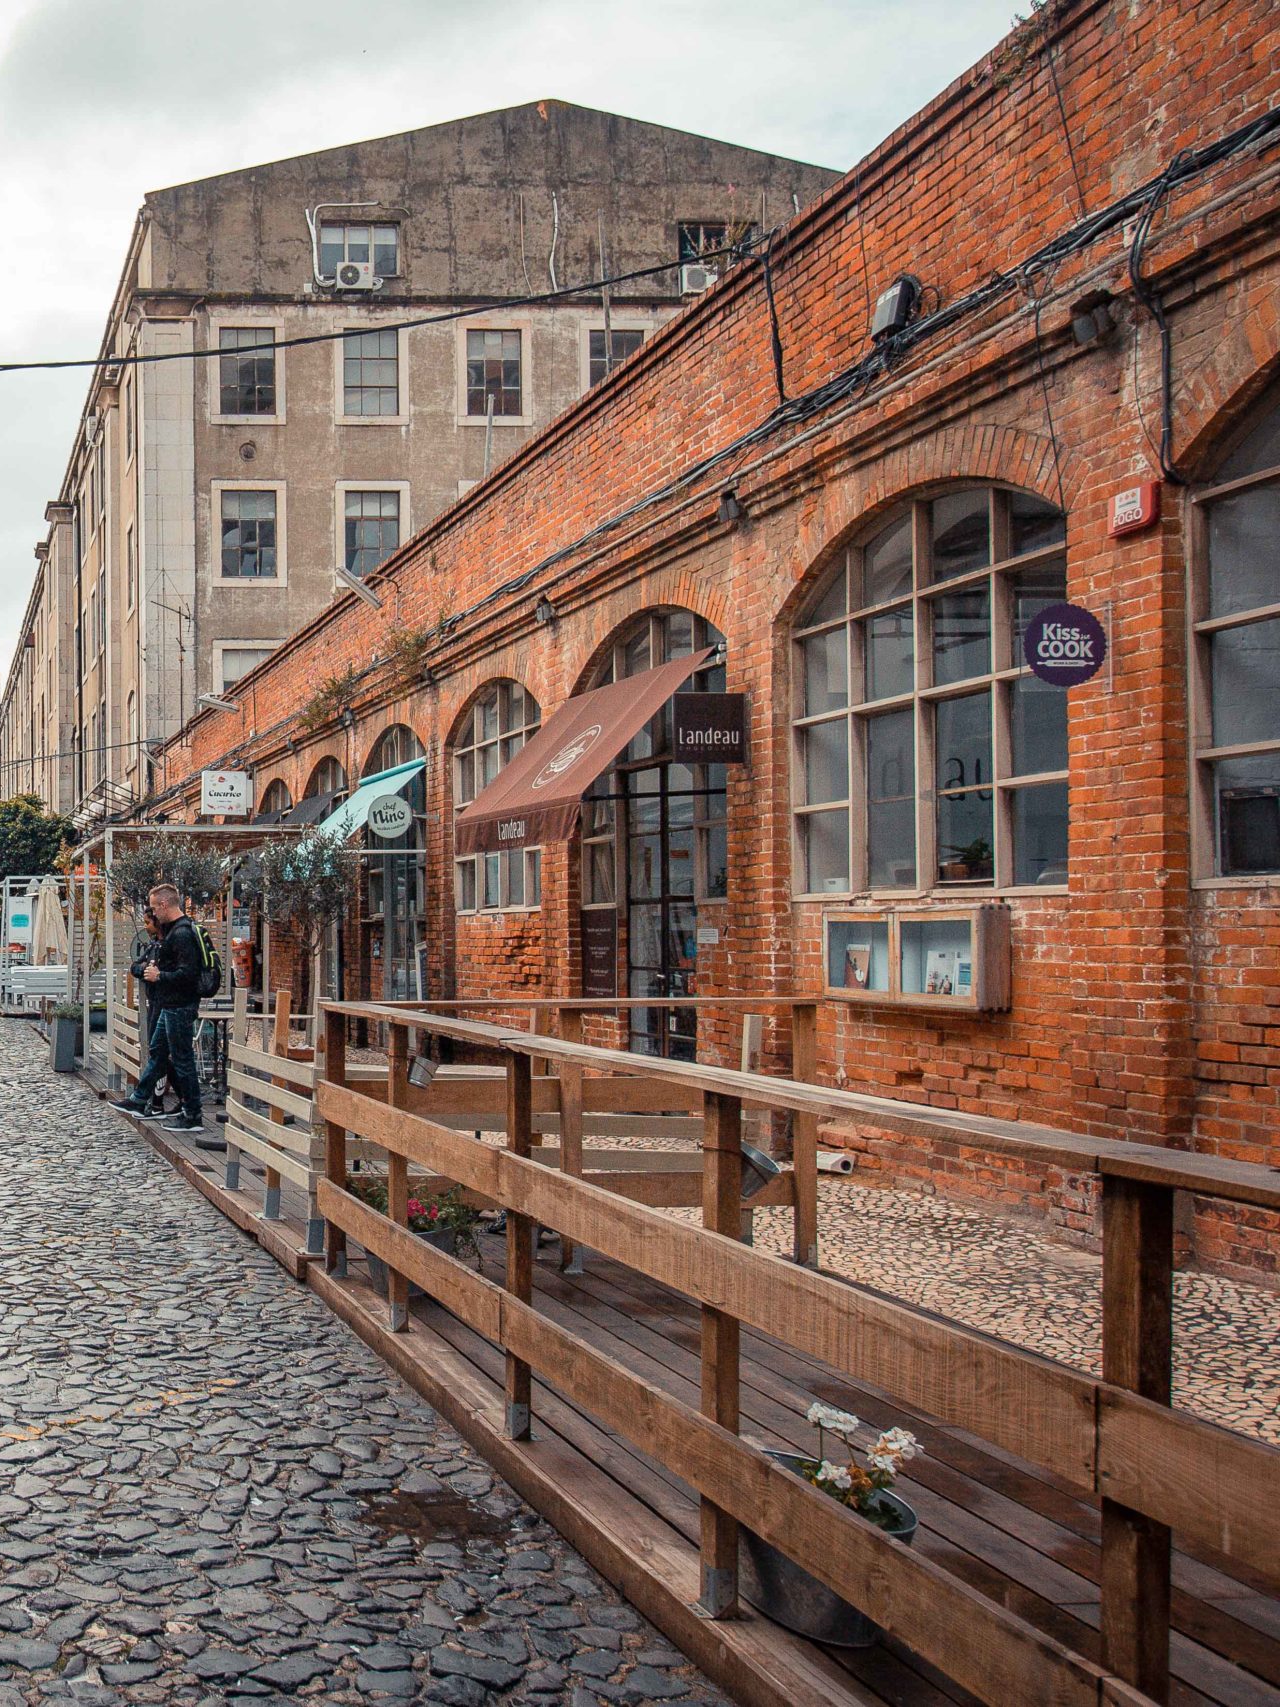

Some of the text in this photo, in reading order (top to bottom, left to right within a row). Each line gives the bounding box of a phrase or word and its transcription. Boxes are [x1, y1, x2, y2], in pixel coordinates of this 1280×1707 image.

[1042, 623, 1080, 640] Kiss
[1037, 641, 1094, 657] COOK
[679, 727, 739, 744] Landeau
[497, 818, 525, 840] Landeau
